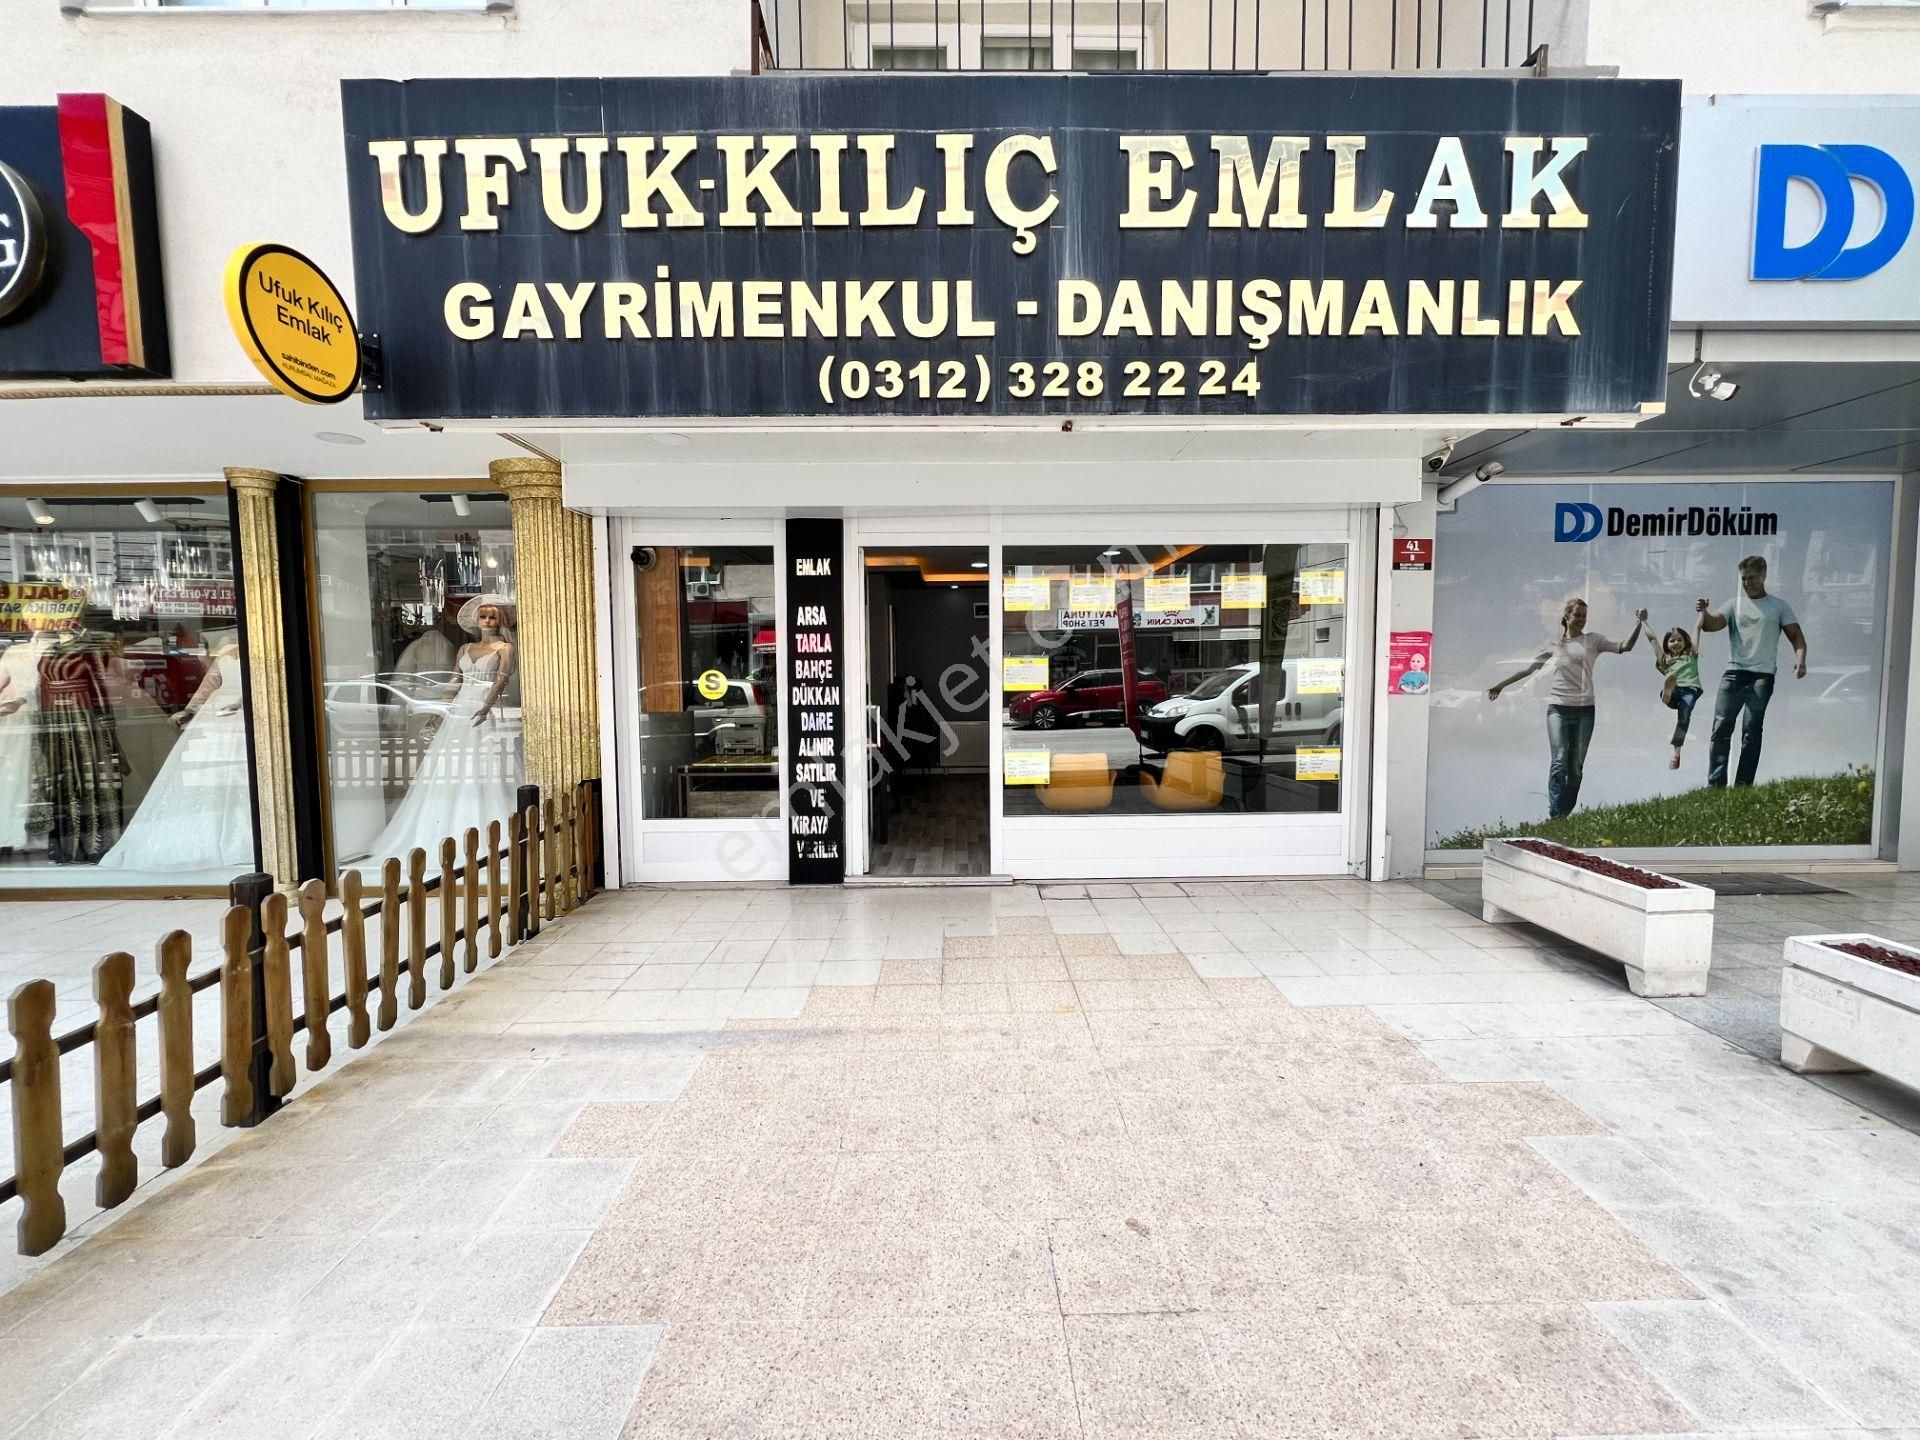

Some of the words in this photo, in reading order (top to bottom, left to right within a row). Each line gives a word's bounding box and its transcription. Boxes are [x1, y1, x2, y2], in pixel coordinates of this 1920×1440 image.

[368, 133, 1060, 255] UFUK-KILIÇ
[1119, 135, 1589, 229] EMLAK
[258, 270, 304, 310] Ufuk
[307, 296, 343, 333] Kılıç
[444, 265, 996, 341] GAYRİMENKUL
[1057, 279, 1583, 351] DANIŞMANLIK
[276, 304, 332, 345] Emlak
[818, 355, 991, 403] (0312)
[1008, 361, 1104, 397] 328
[1607, 506, 1778, 537] DemirDöküm
[1406, 540, 1420, 551] 41
[795, 558, 831, 576] EMLAK
[796, 605, 828, 626] ARSA
[795, 633, 832, 653] TARLA
[795, 660, 833, 683] BAHÇE
[792, 683, 840, 706] DÜKKAN
[798, 737, 835, 757] ALINIR
[795, 763, 837, 783] SATILIR
[809, 788, 826, 808] VE
